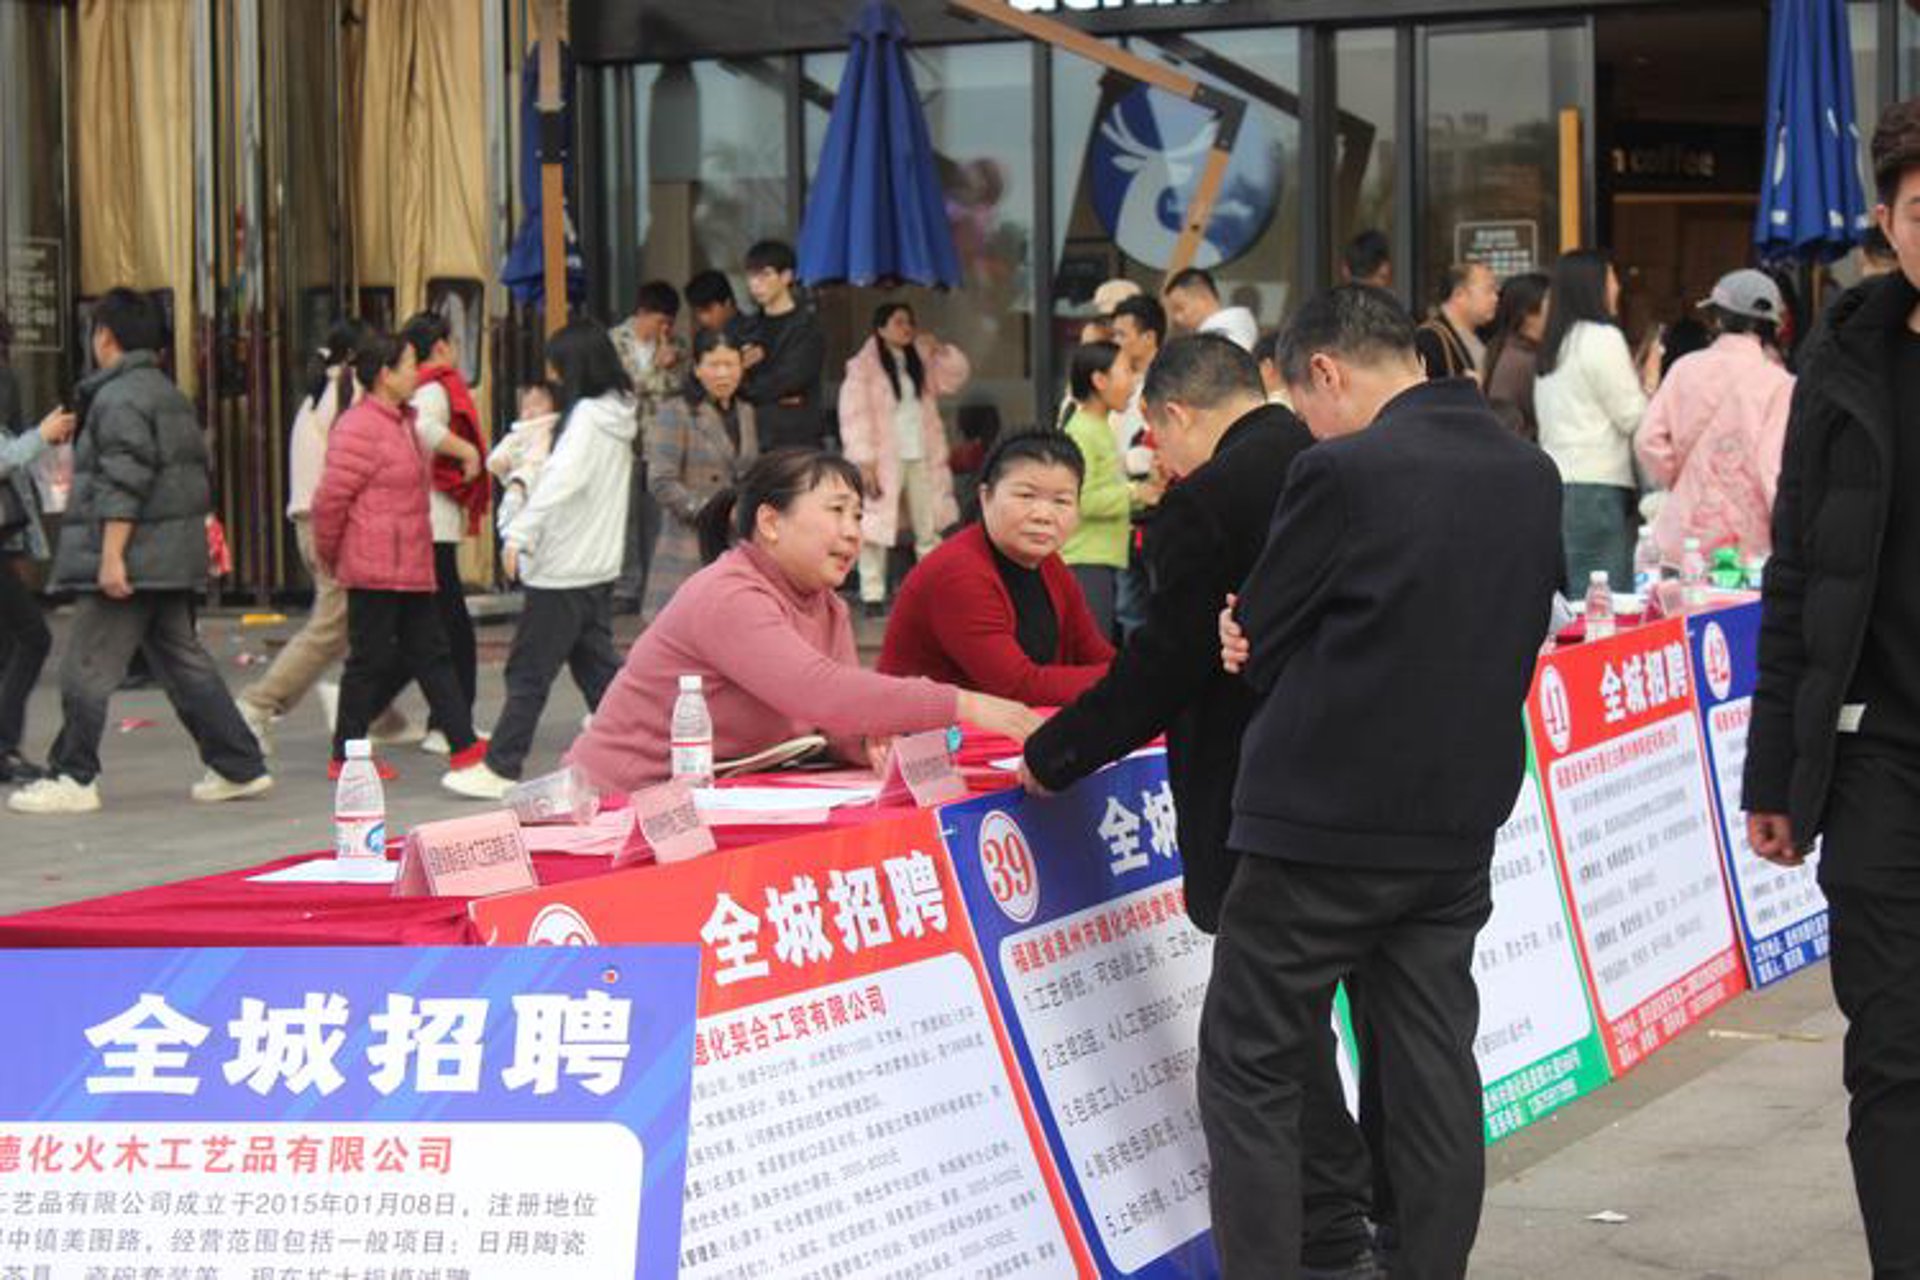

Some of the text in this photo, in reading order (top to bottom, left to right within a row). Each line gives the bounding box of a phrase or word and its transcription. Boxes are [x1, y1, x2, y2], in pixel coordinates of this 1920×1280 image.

[1600, 640, 1689, 724] 全城招聘
[983, 834, 1031, 903] 39
[700, 849, 948, 986] 全城招聘
[84, 990, 634, 1097] 全城招聘
[0, 1135, 454, 1175] 德化火木工艺品有限公司
[0, 1191, 598, 1218] 艺品有限公司成立于2015年01月08日，注册地位
